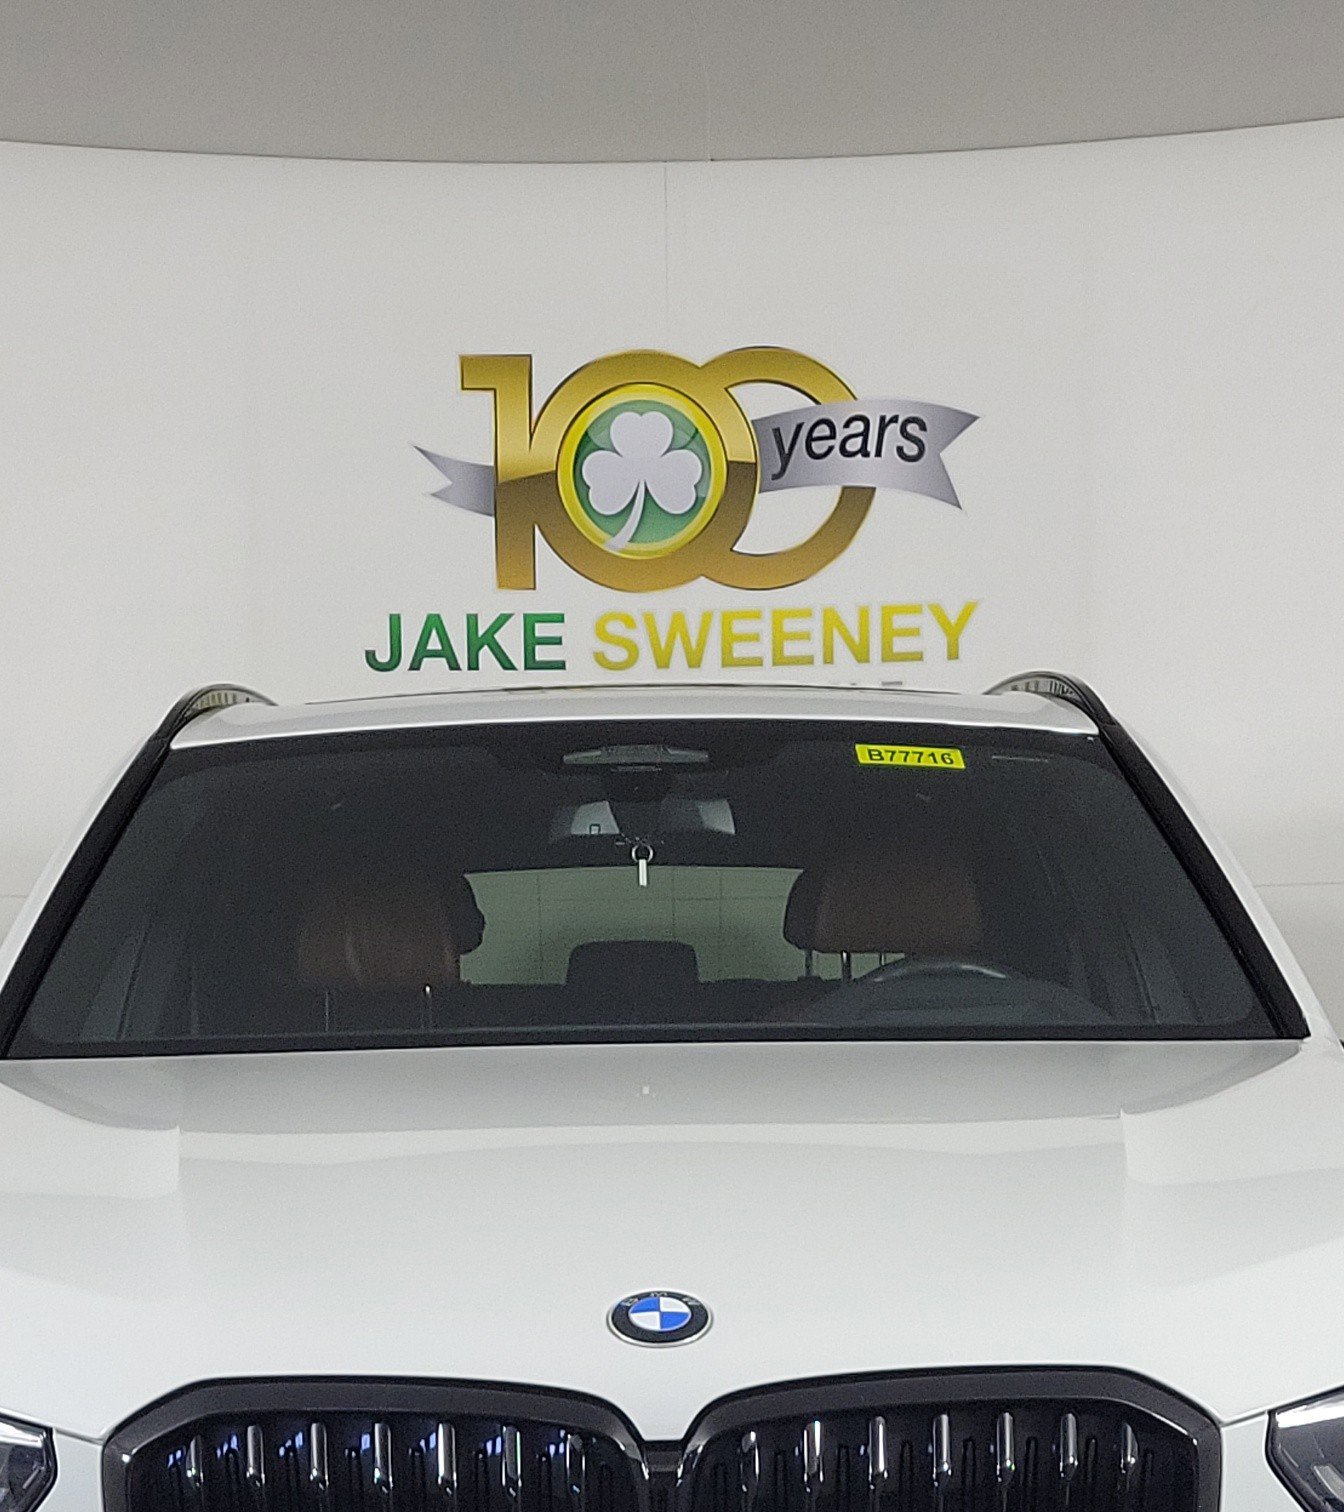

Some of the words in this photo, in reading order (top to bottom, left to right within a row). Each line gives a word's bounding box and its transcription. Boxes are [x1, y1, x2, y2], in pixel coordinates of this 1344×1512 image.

[459, 346, 875, 591] 100
[770, 409, 927, 480] years
[364, 613, 566, 672] JAKE
[593, 602, 979, 670] SWEENEY
[867, 748, 954, 765] B77716
